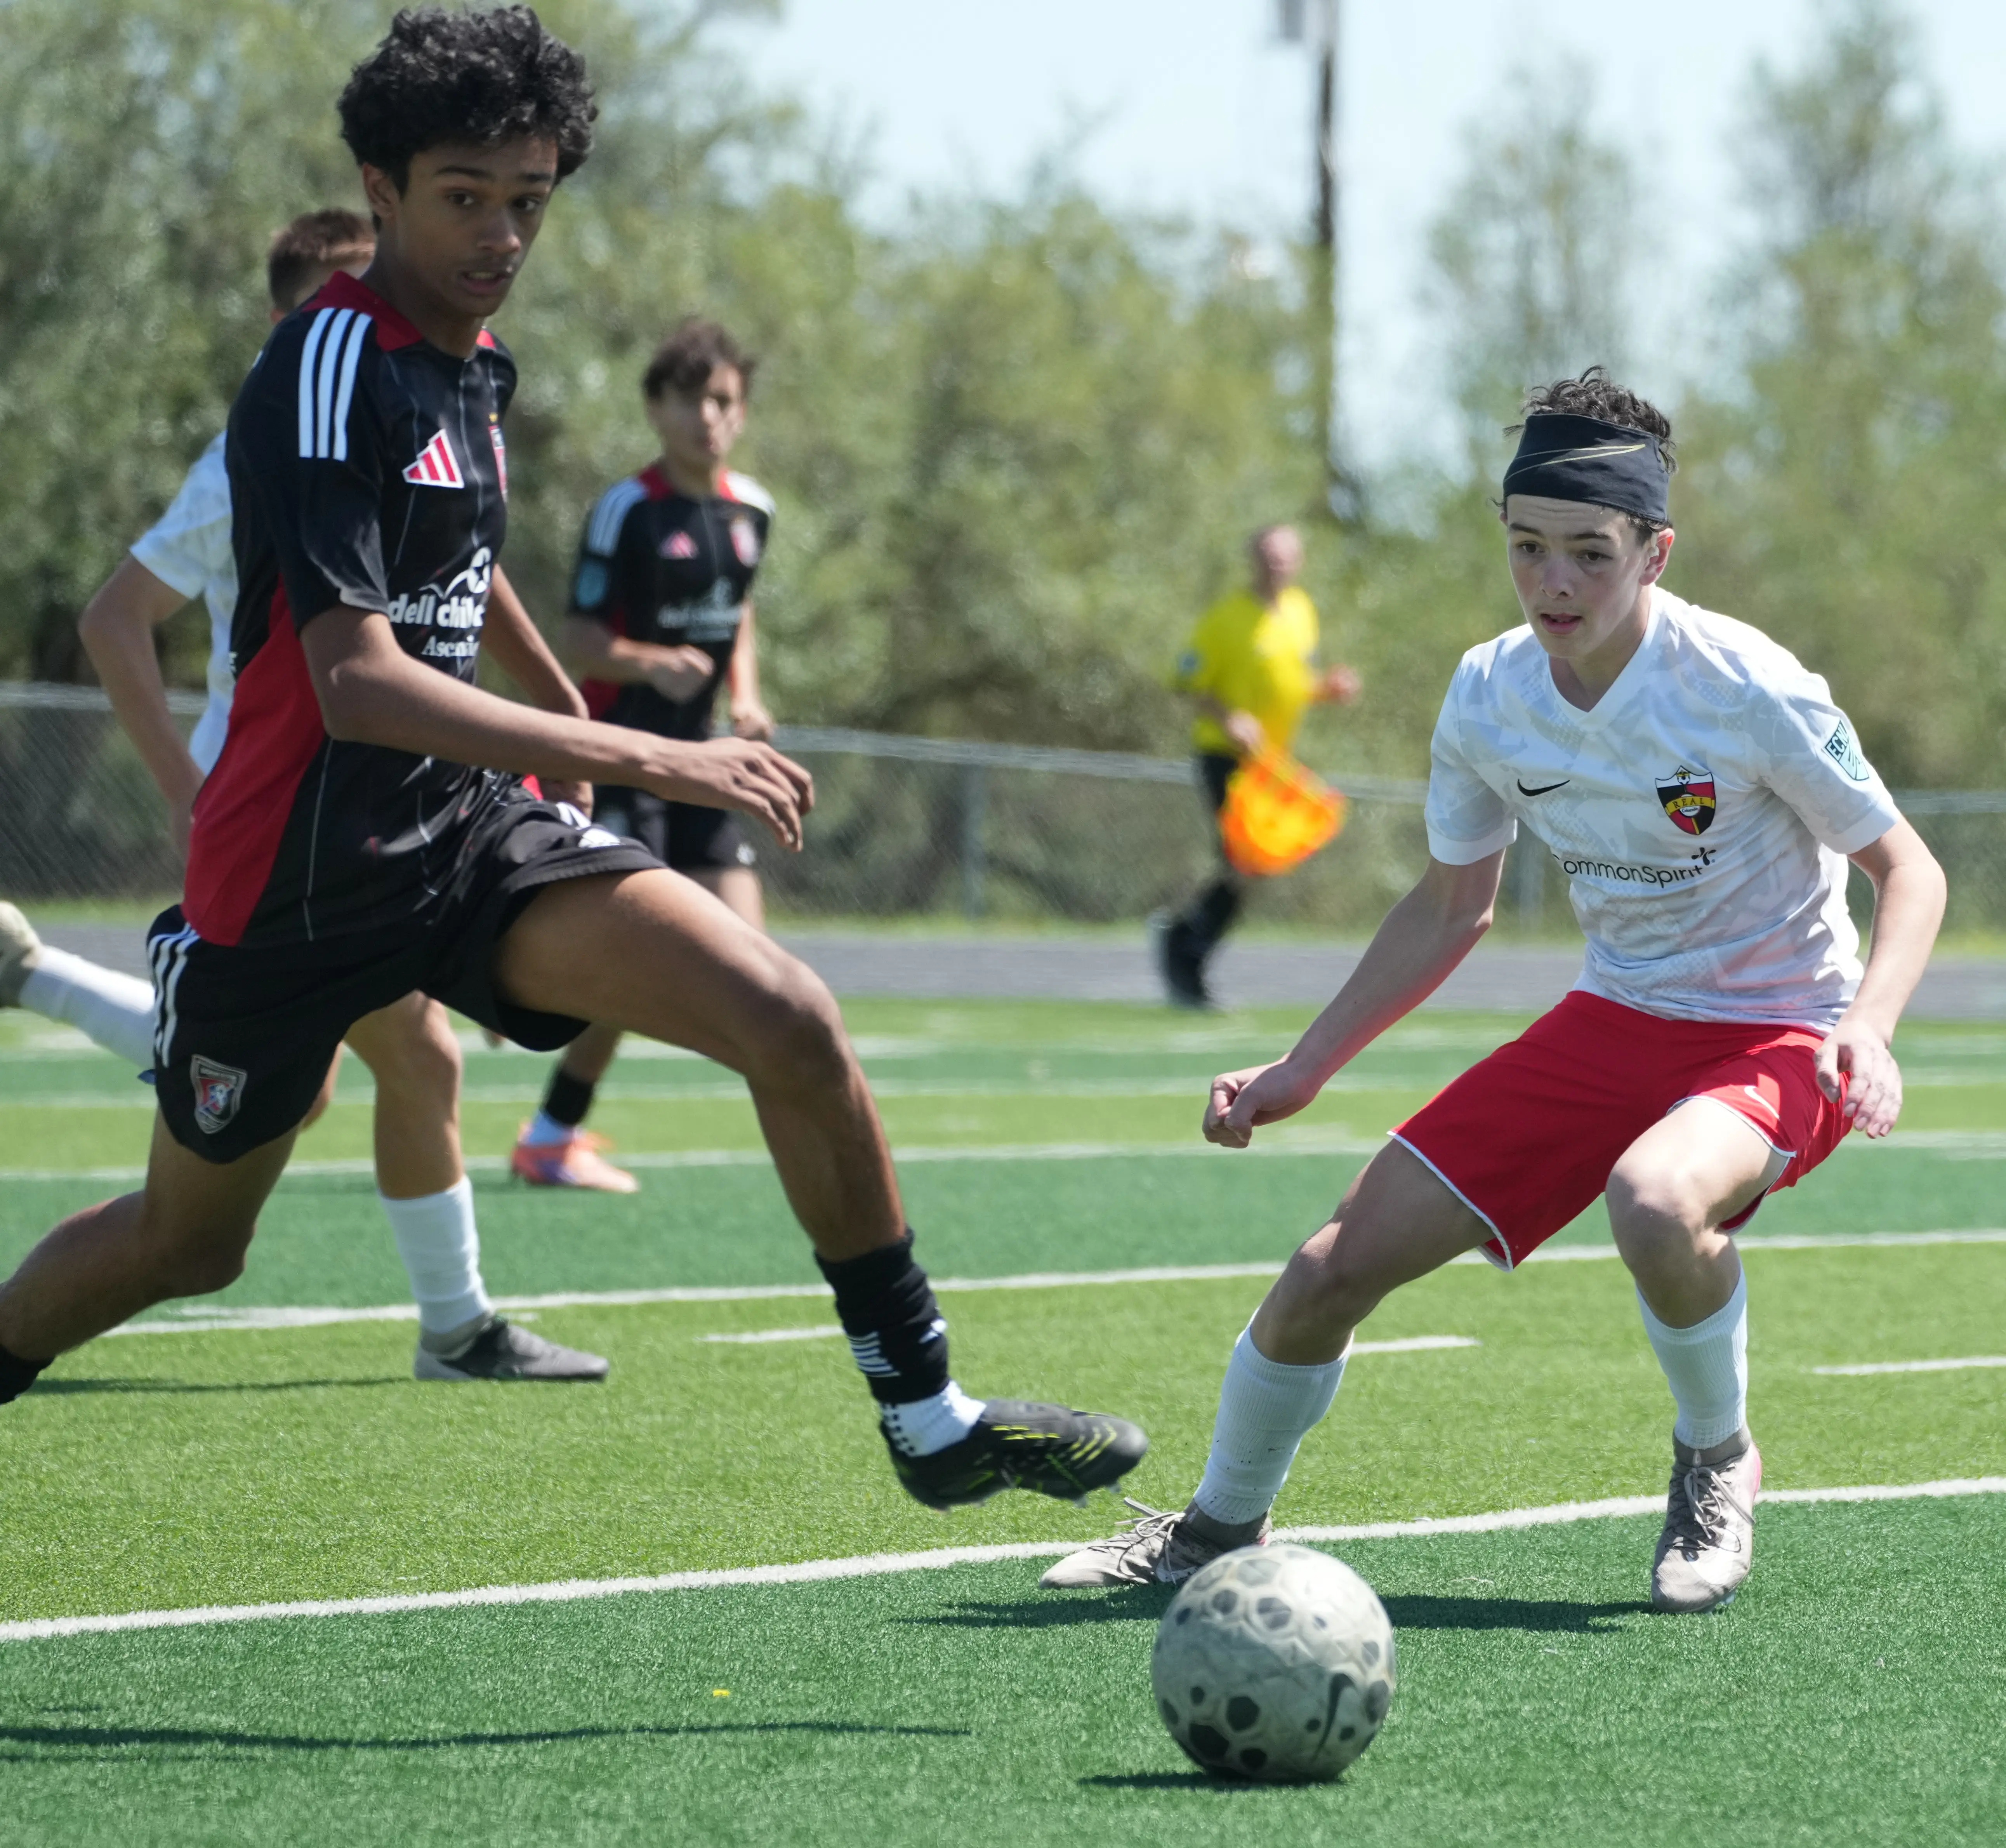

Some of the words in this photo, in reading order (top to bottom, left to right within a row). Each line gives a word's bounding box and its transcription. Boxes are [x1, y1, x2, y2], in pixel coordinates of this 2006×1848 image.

[388, 593, 436, 625] dell
[1672, 797, 1705, 808] REAL
[1553, 854, 1703, 888] ommonSpirit
